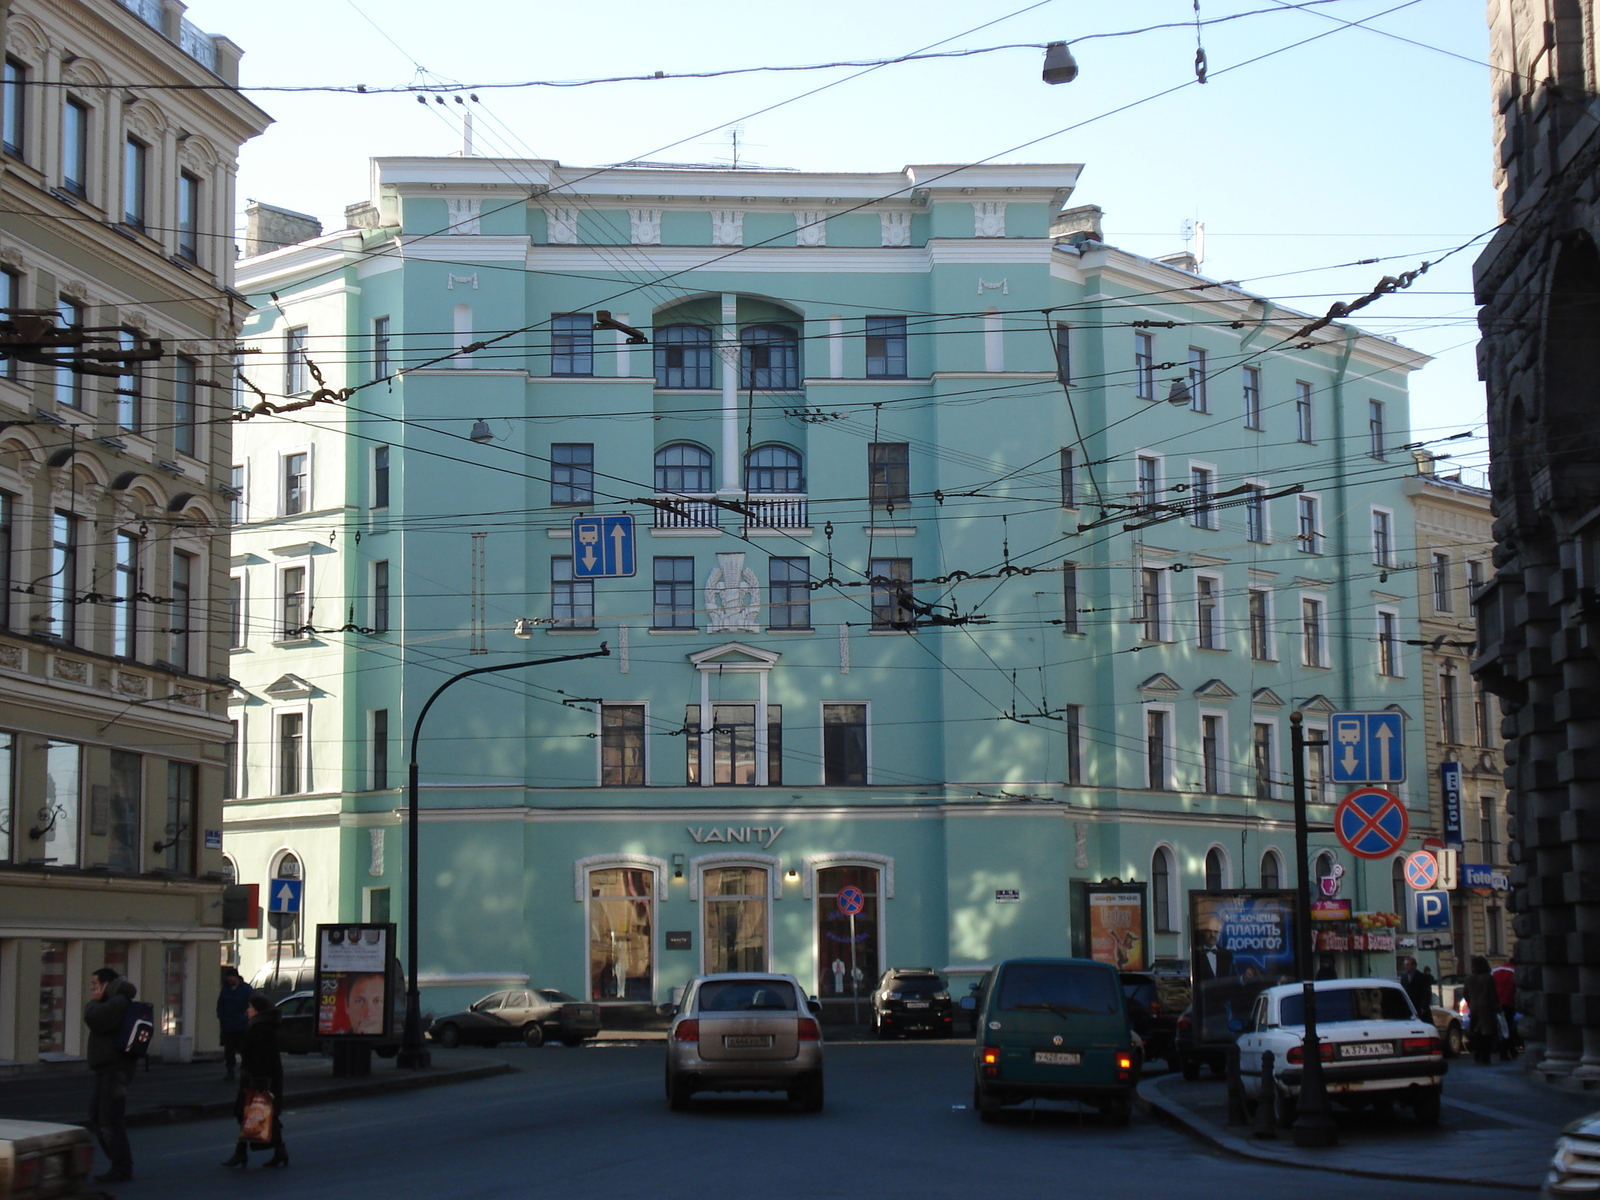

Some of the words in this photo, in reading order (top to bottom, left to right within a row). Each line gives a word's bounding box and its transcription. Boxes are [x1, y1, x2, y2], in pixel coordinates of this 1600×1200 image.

[1447, 792, 1459, 832] Foto
[687, 826, 784, 850] VANITY
[1466, 869, 1491, 886] Foto
[1422, 895, 1442, 925] P
[1225, 913, 1239, 923] НЕ
[1240, 914, 1280, 924] ХОЧЕШЬ
[1226, 924, 1281, 936] ПЛАТИТЬ
[1226, 937, 1283, 951] ДОРОГО?
[321, 995, 337, 1005] 30
